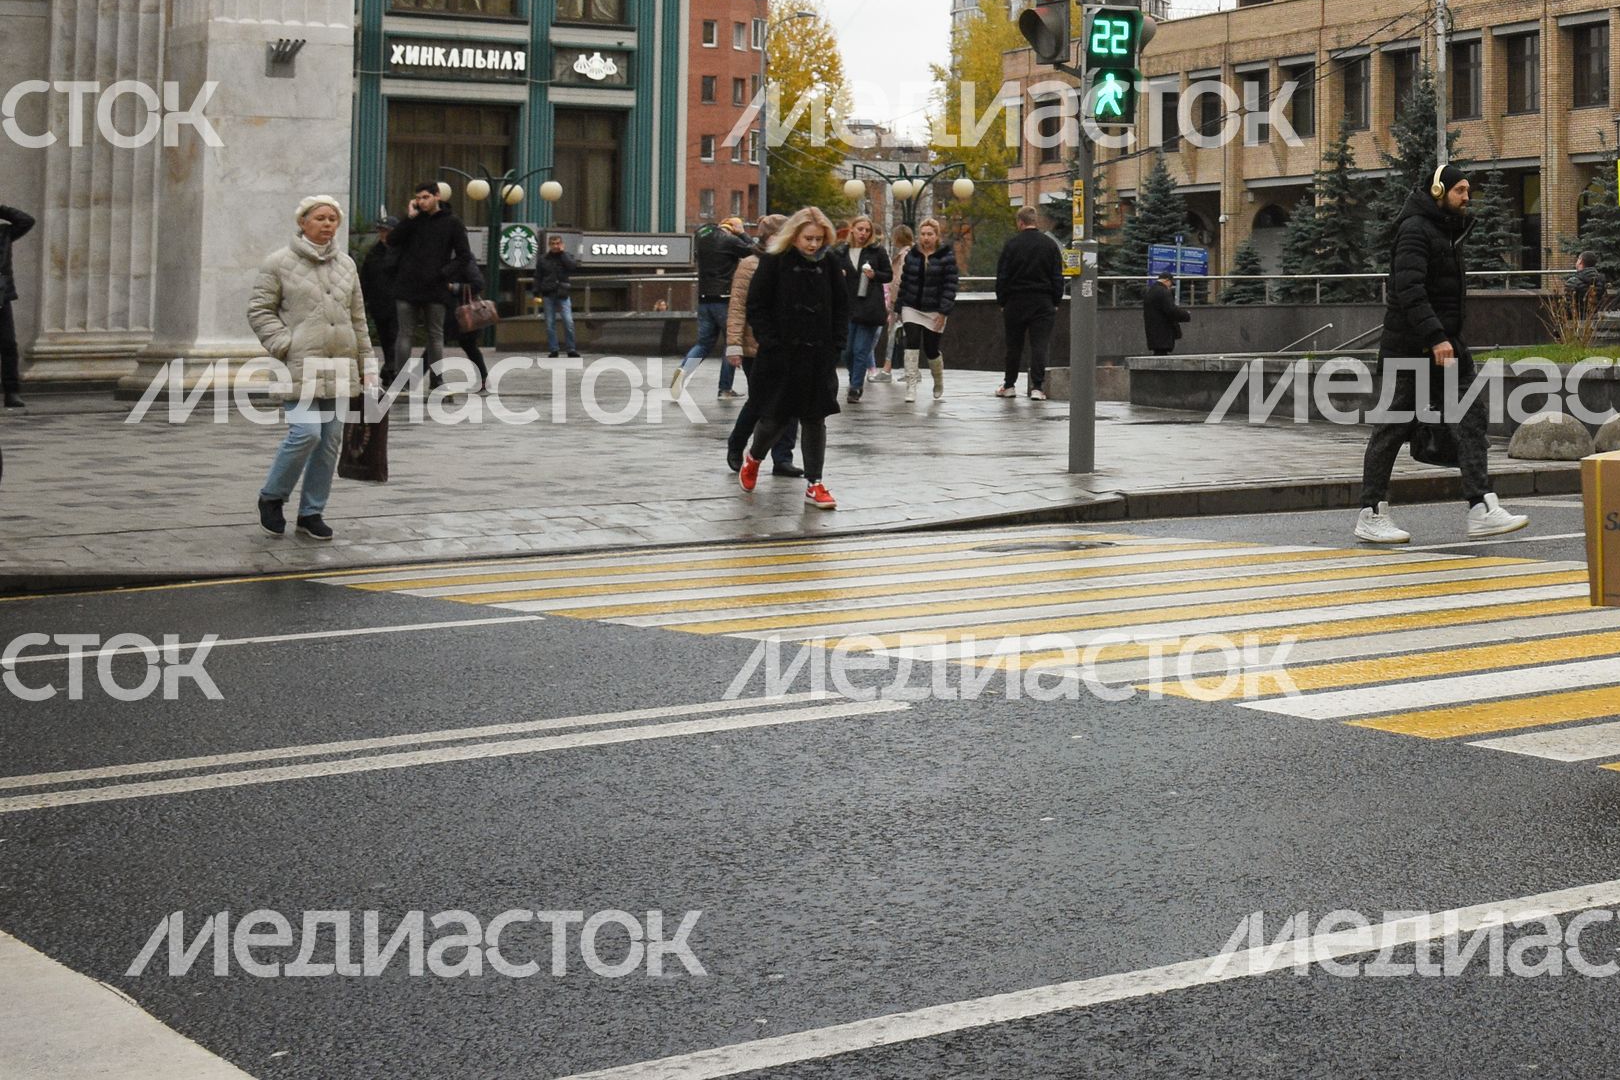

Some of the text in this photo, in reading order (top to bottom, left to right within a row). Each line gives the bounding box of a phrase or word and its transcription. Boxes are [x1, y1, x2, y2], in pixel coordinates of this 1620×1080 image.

[1092, 19, 1129, 55] 22
[390, 44, 526, 71] ХИНКАЛЬНАЯ
[592, 243, 668, 256] STARBUCKS
